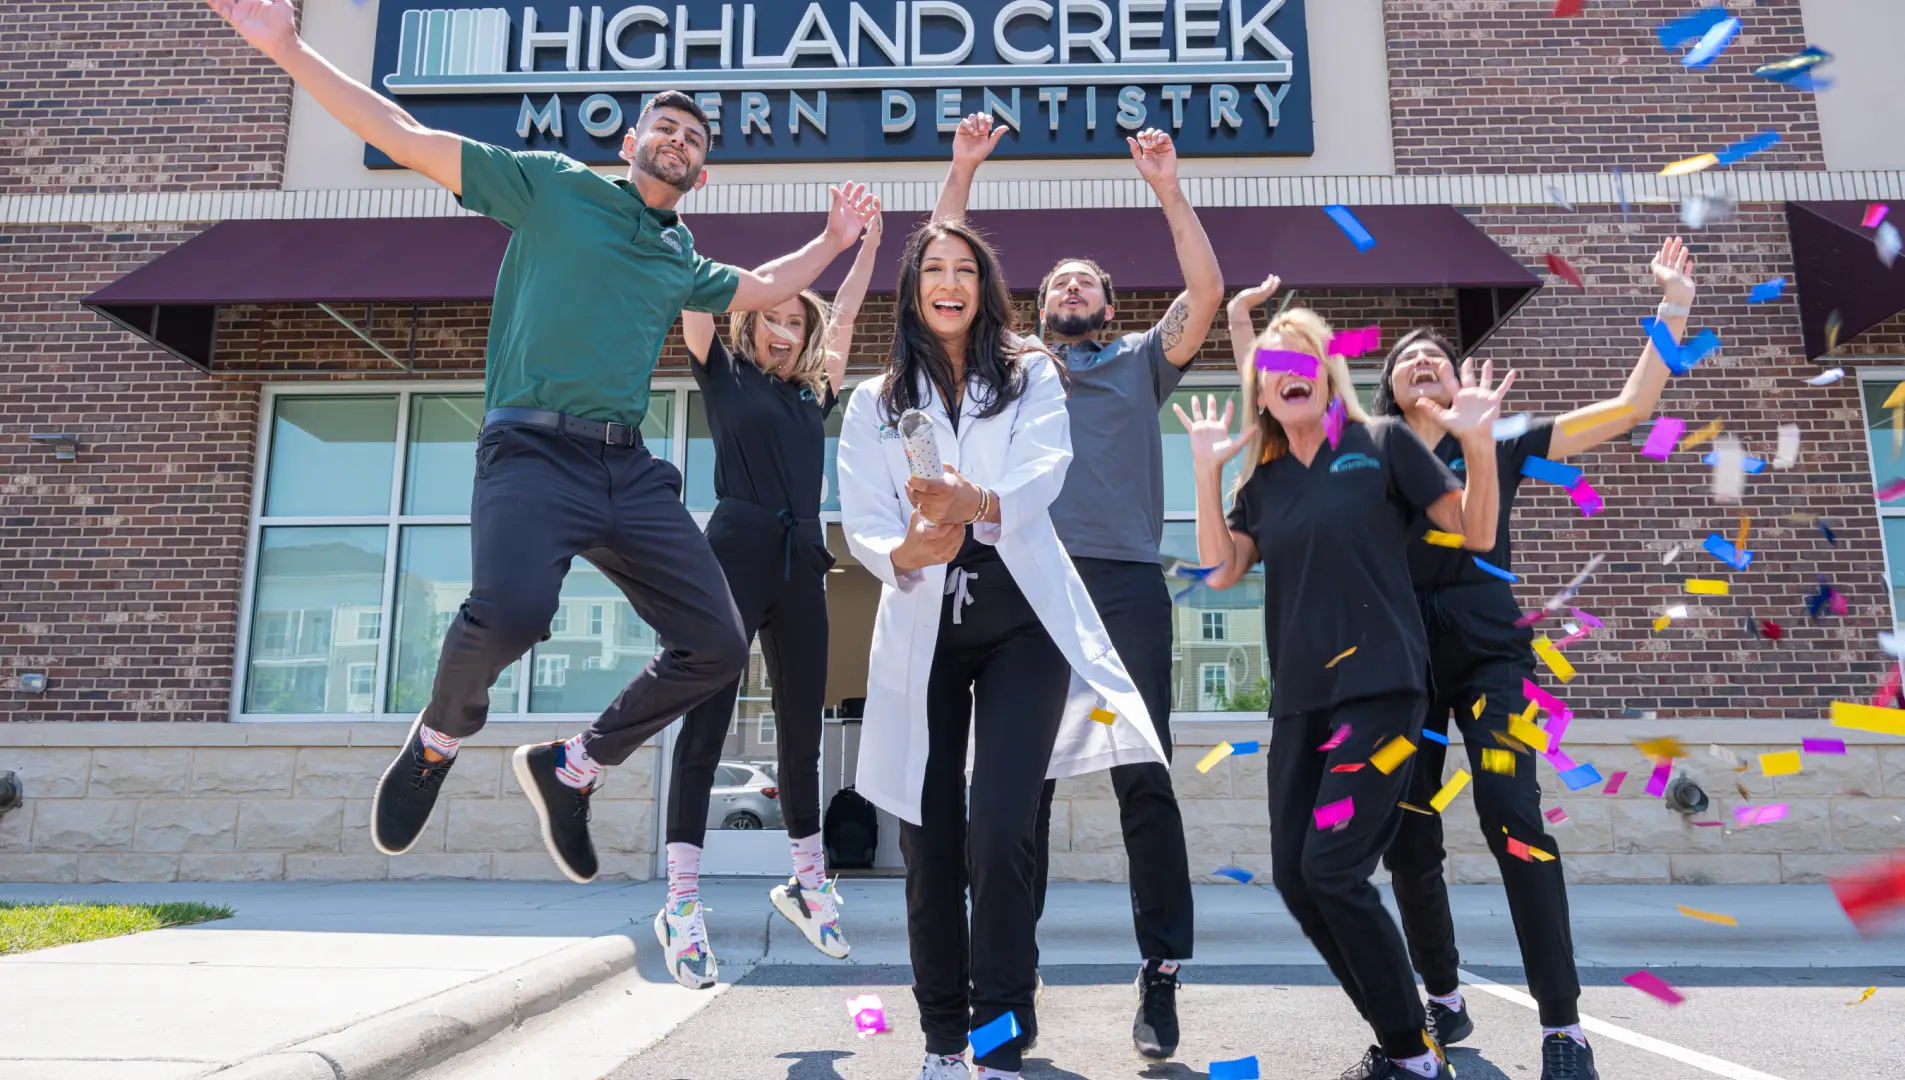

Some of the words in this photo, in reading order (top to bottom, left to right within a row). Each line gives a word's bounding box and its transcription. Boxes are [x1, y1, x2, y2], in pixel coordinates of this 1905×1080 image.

[520, 2, 972, 72] HIGHLAND
[993, 0, 1293, 65] CREEK
[516, 90, 828, 138] MOERN
[881, 83, 1292, 133] DENTISTRY
